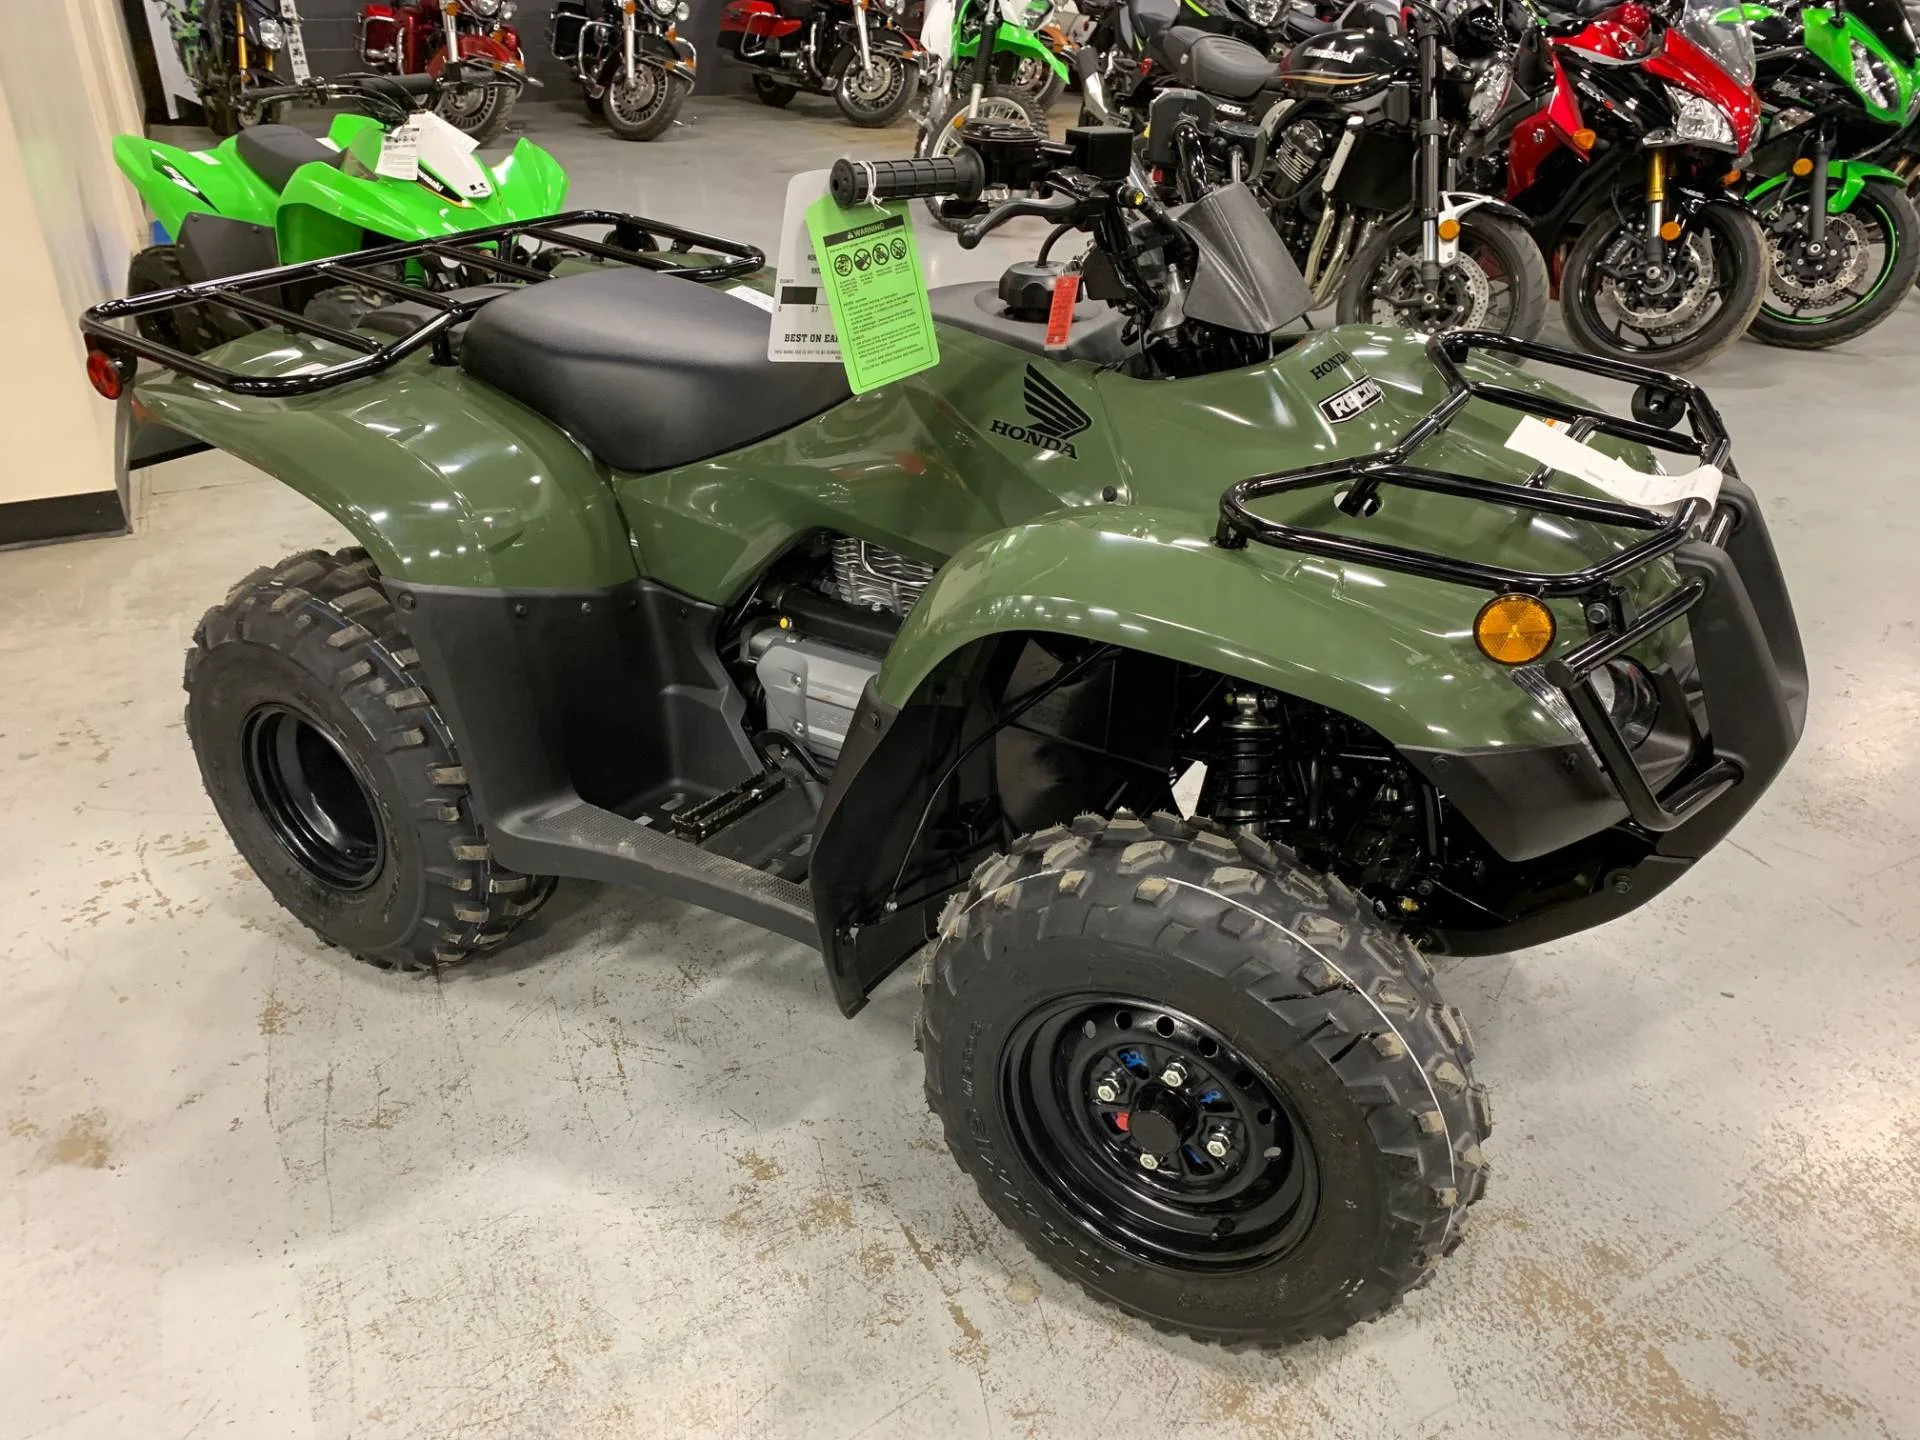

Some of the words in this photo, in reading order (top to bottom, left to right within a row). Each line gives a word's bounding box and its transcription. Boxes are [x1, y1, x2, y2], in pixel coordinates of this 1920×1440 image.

[853, 222, 885, 237] WARNING
[784, 333, 807, 343] BEST
[809, 333, 821, 343] ON
[1310, 350, 1351, 380] HONDA
[989, 419, 1078, 460] HONDA
